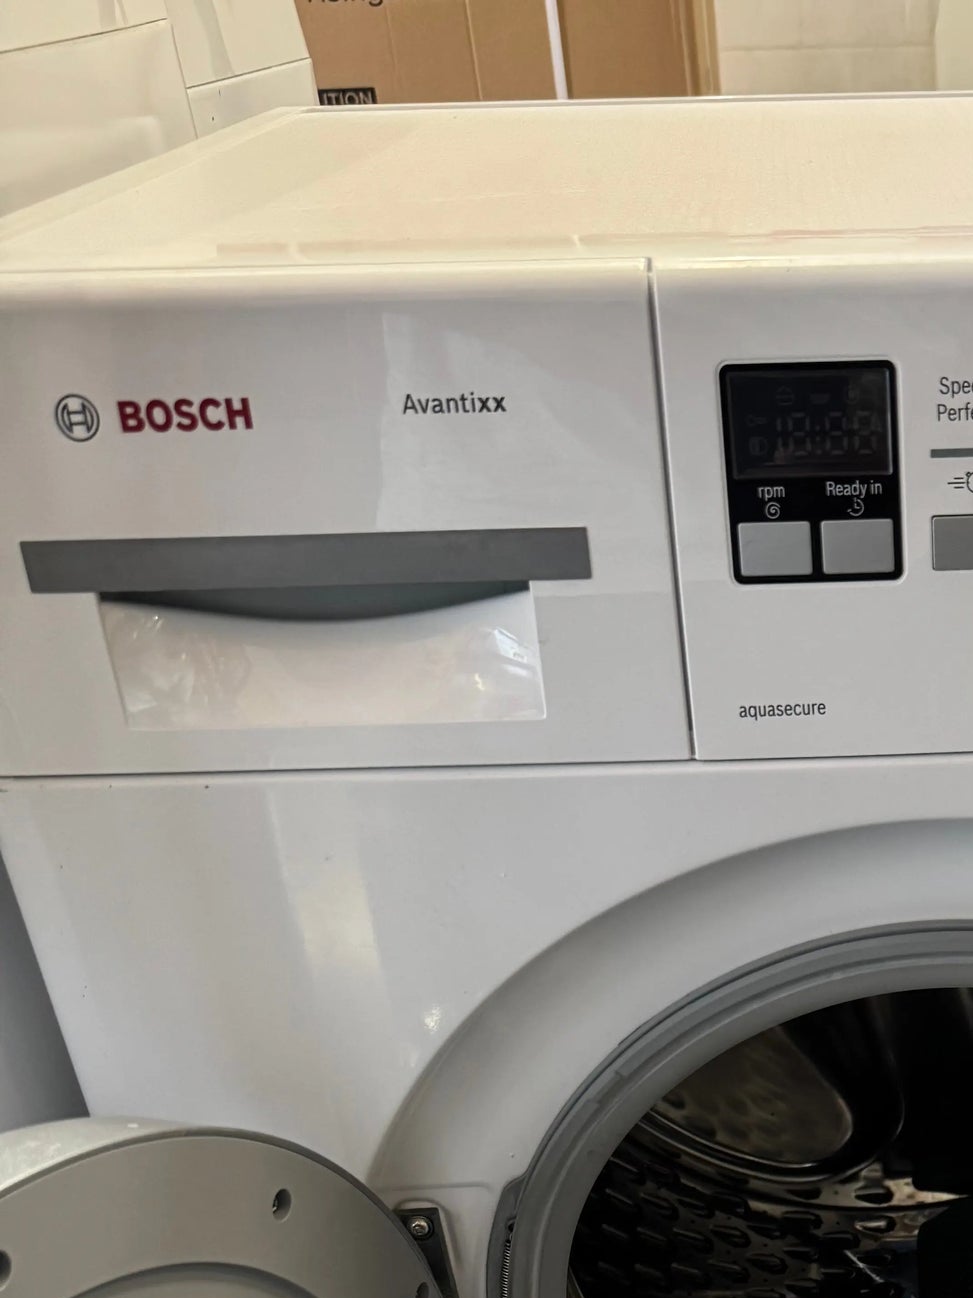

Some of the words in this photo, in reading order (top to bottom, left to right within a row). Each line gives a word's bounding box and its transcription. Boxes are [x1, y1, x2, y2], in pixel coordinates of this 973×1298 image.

[402, 392, 507, 415] Avantixx
[117, 397, 254, 433] BOSCH
[758, 486, 785, 500] rpm
[826, 481, 867, 498] Ready
[870, 481, 882, 495] in
[739, 702, 826, 720] aquasecure
